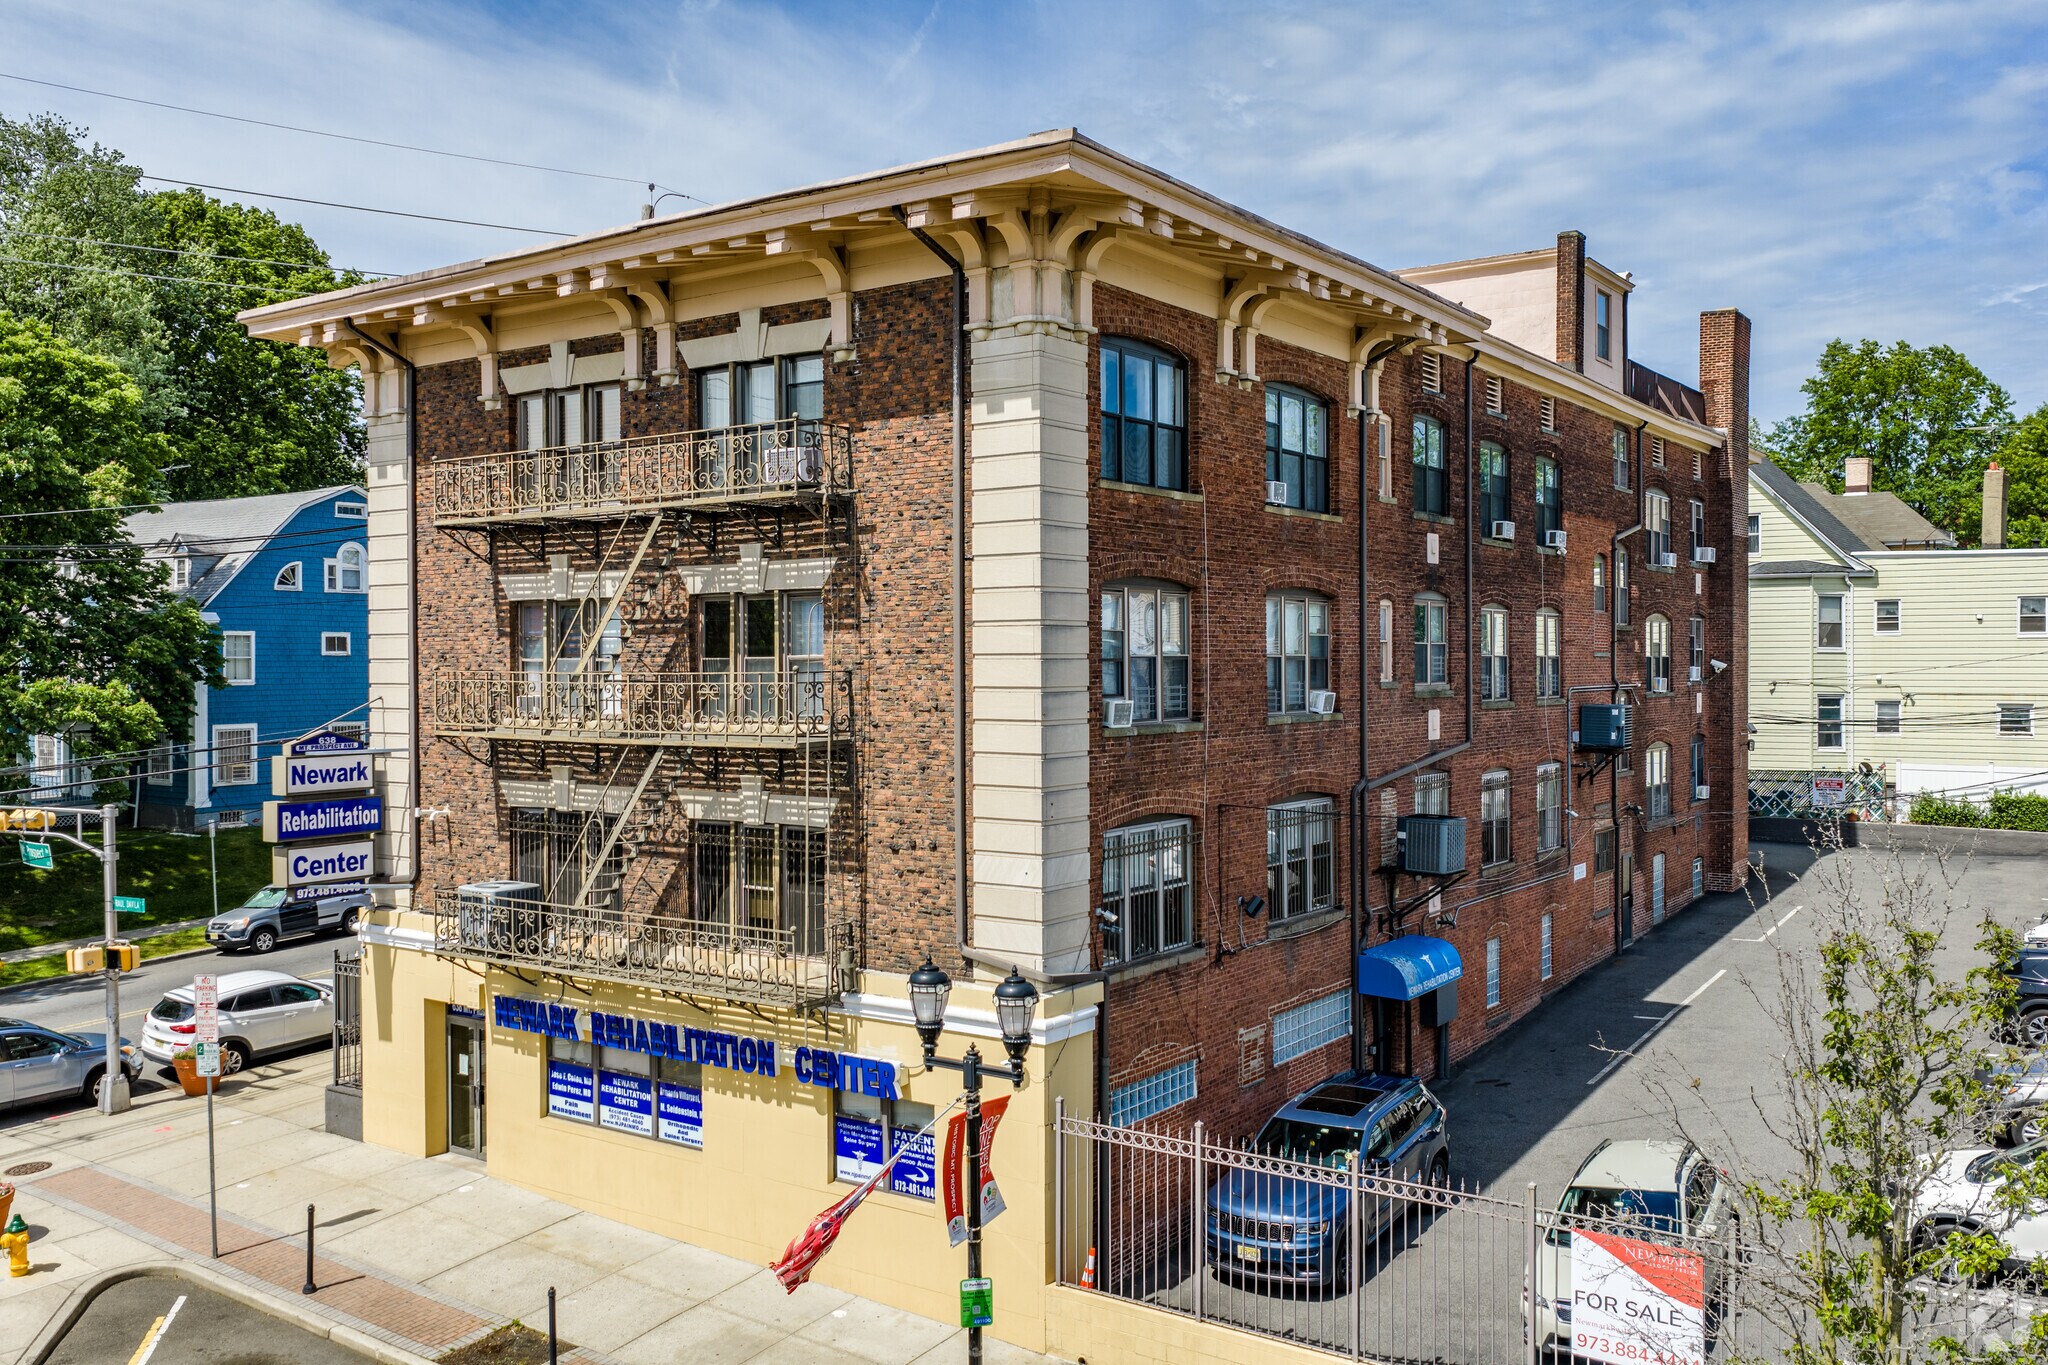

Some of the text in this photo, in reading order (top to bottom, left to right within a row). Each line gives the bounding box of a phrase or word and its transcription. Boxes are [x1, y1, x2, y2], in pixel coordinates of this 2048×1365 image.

[318, 736, 337, 744] 638
[291, 761, 369, 786] Newark
[281, 805, 379, 833] Rehabilitation
[293, 851, 369, 878] Center
[198, 1045, 203, 1053] 2
[495, 995, 902, 1100] NEWARK REHABILITATION CENTER
[552, 1081, 567, 1092] Edwin
[567, 1085, 582, 1096] Perez,
[612, 1077, 639, 1090] NEWARK
[601, 1083, 651, 1102] REHABILITATION
[565, 1099, 578, 1108] Pain
[613, 1095, 639, 1109] CENTER
[551, 1105, 592, 1120] Management
[608, 1107, 645, 1120] Accident Cases
[608, 1113, 621, 1121] (973)
[602, 1119, 651, 1134] www.NJPAINMD.com
[667, 1120, 699, 1133] Orthopedic
[677, 1129, 689, 1137] And
[837, 1121, 883, 1137] Orthopedic Surgery
[664, 1132, 703, 1146] Spine Surgery
[839, 1128, 881, 1142] Pain Management
[843, 1136, 877, 1149] Spine Surgery
[950, 1123, 960, 1158] HISTORIC
[917, 1160, 936, 1170] AVENU
[894, 1179, 936, 1199] 973-481-404
[950, 1173, 958, 1213] PROSPECT
[1622, 1243, 1699, 1271] NEWMARK
[1574, 1289, 1682, 1328] FOR SALE
